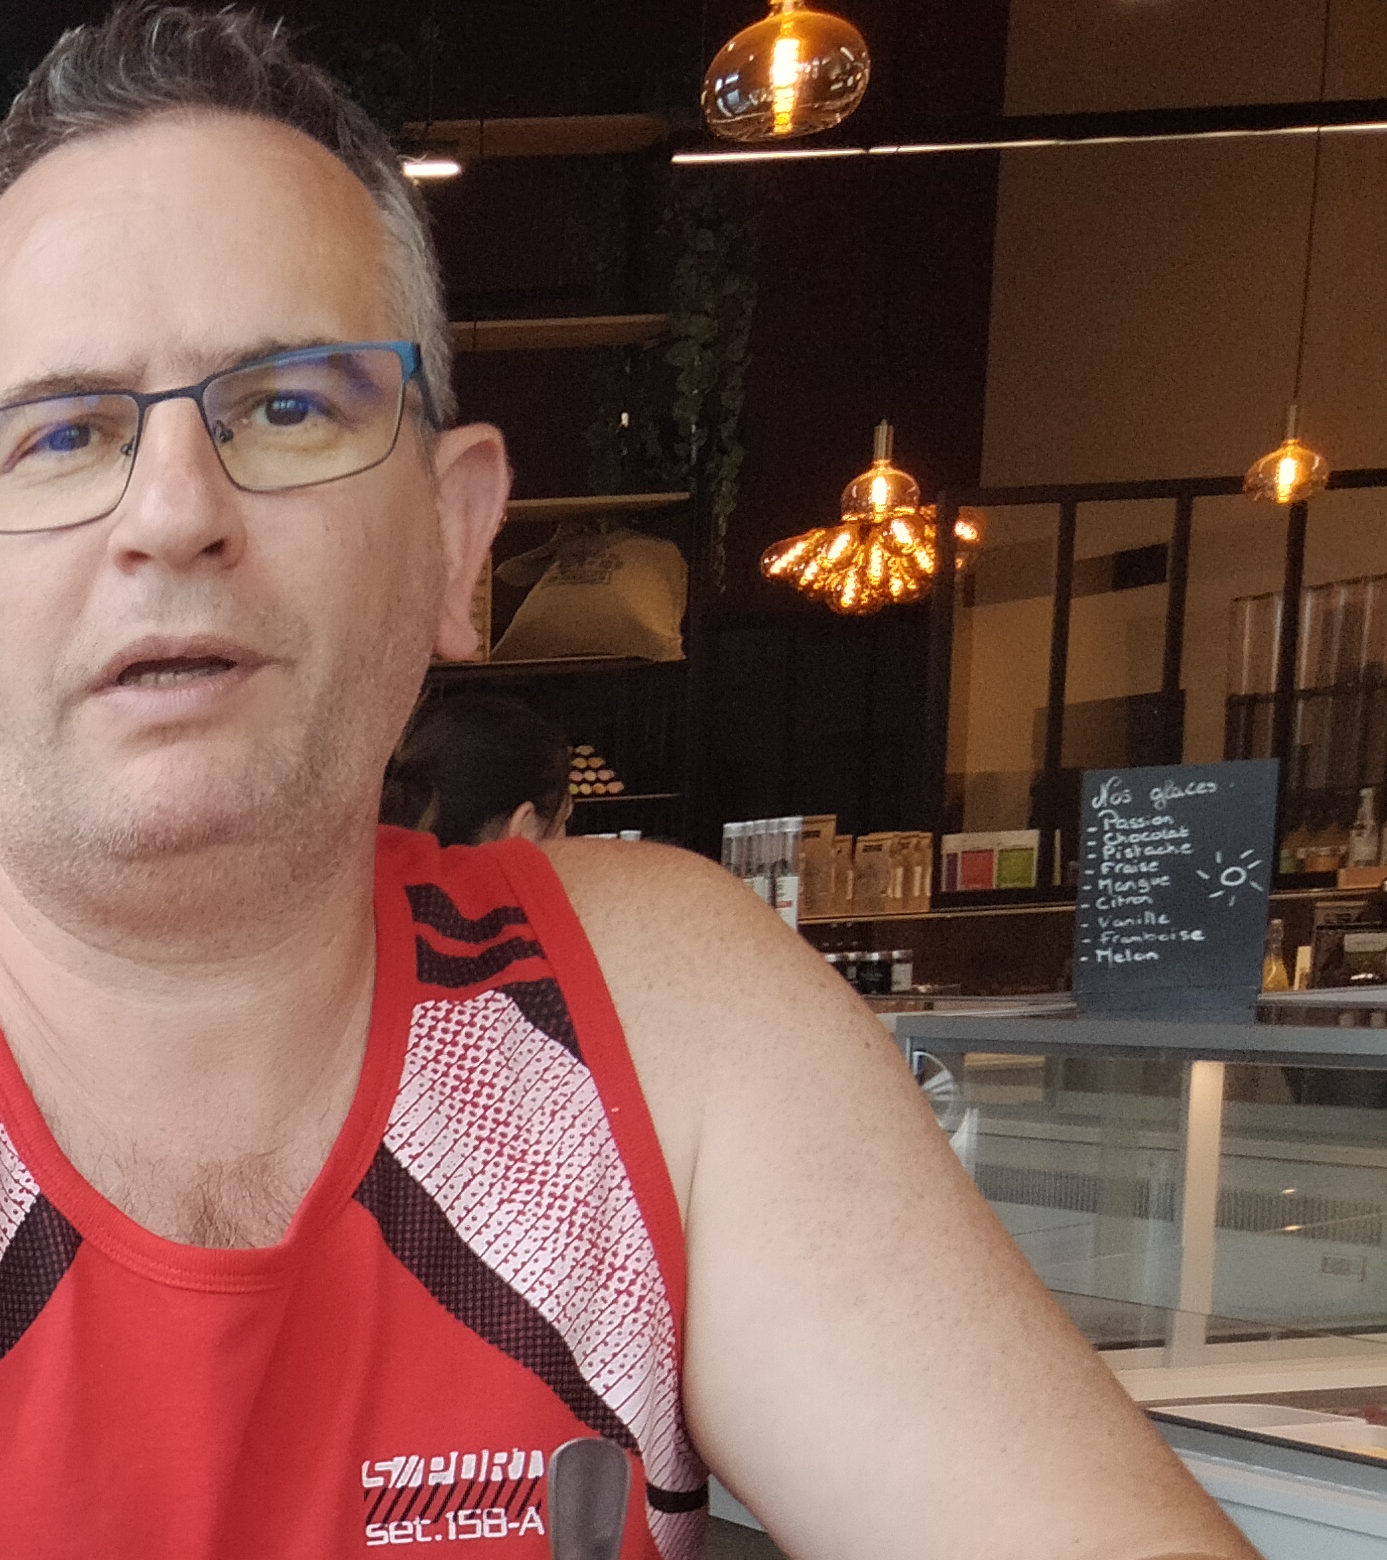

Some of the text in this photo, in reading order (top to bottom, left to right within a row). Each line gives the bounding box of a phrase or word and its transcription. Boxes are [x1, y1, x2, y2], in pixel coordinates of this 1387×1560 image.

[1092, 776, 1217, 810] Nos glaces
[1098, 809, 1174, 830] Passion
[1104, 825, 1189, 845] Chocolat
[1102, 842, 1193, 860] Pistache
[1100, 860, 1160, 875] Fraise
[1098, 875, 1171, 894] Mangue
[1096, 895, 1153, 909] Citron
[1098, 910, 1170, 928] Vanille
[1100, 929, 1206, 944] Framboise
[1095, 948, 1160, 966] Melon
[365, 1506, 545, 1546] set.158-A
